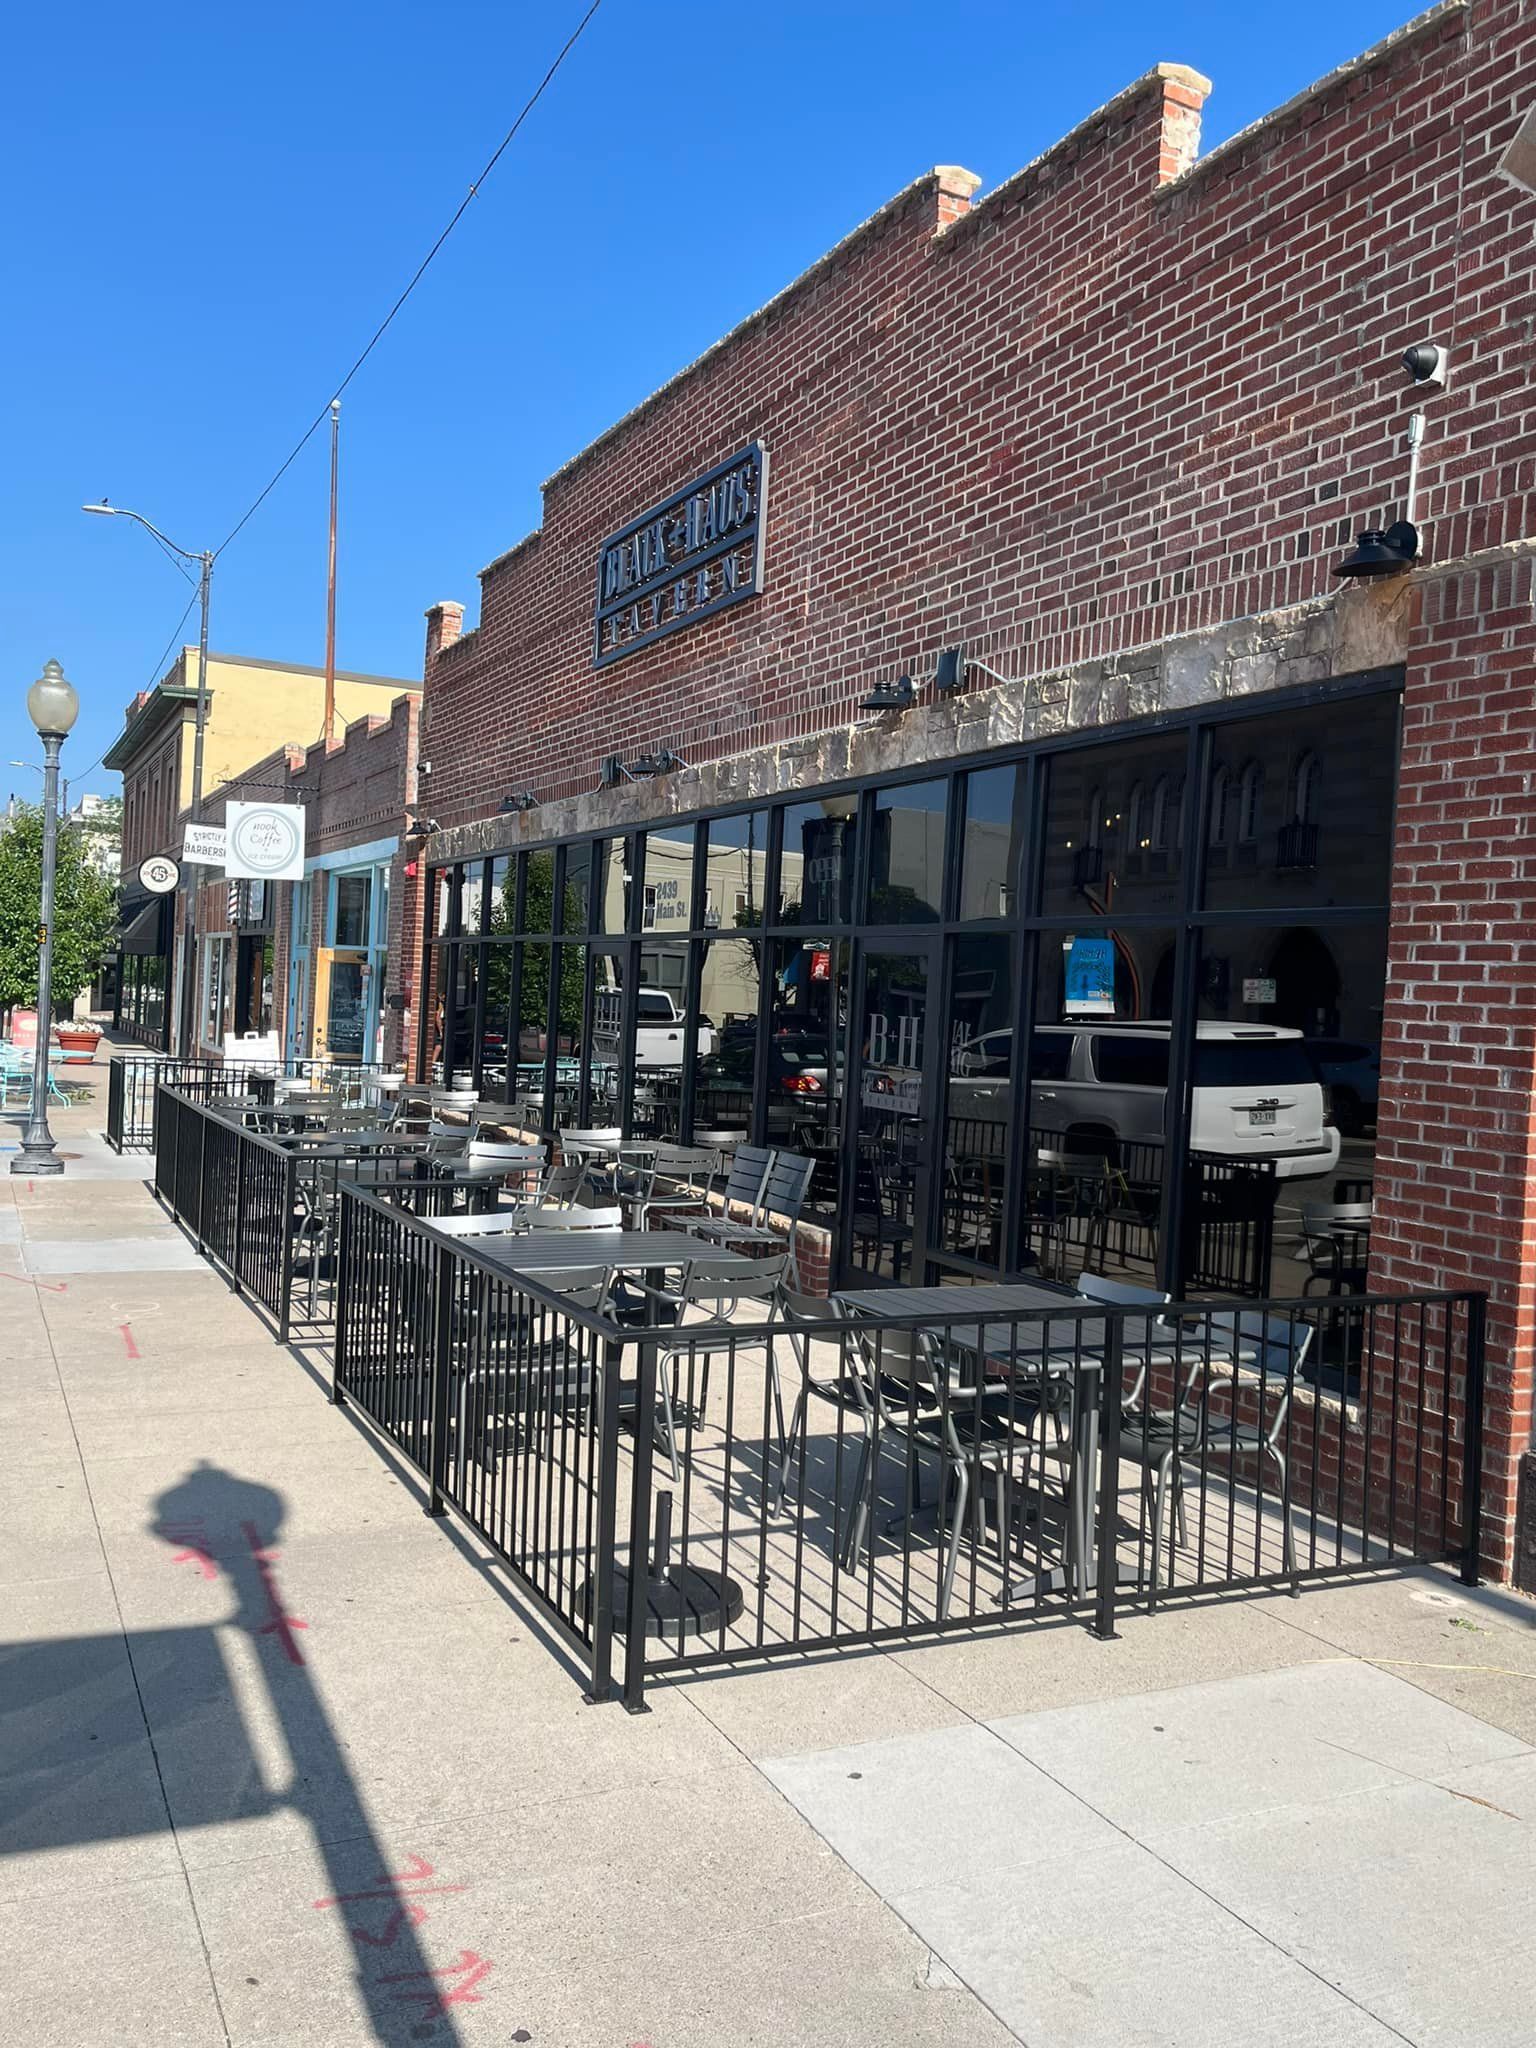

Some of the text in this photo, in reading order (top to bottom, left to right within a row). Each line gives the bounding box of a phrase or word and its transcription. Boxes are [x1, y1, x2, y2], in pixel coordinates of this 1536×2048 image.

[604, 517, 672, 600] BLACK
[684, 463, 758, 554] HAUS
[608, 551, 746, 646] TAVERN
[192, 831, 221, 842] STRICTLY
[249, 832, 282, 847] Coffee
[152, 868, 166, 881] 45
[656, 880, 678, 900] 2439
[656, 901, 675, 920] Main
[867, 1012, 921, 1069] B+H
